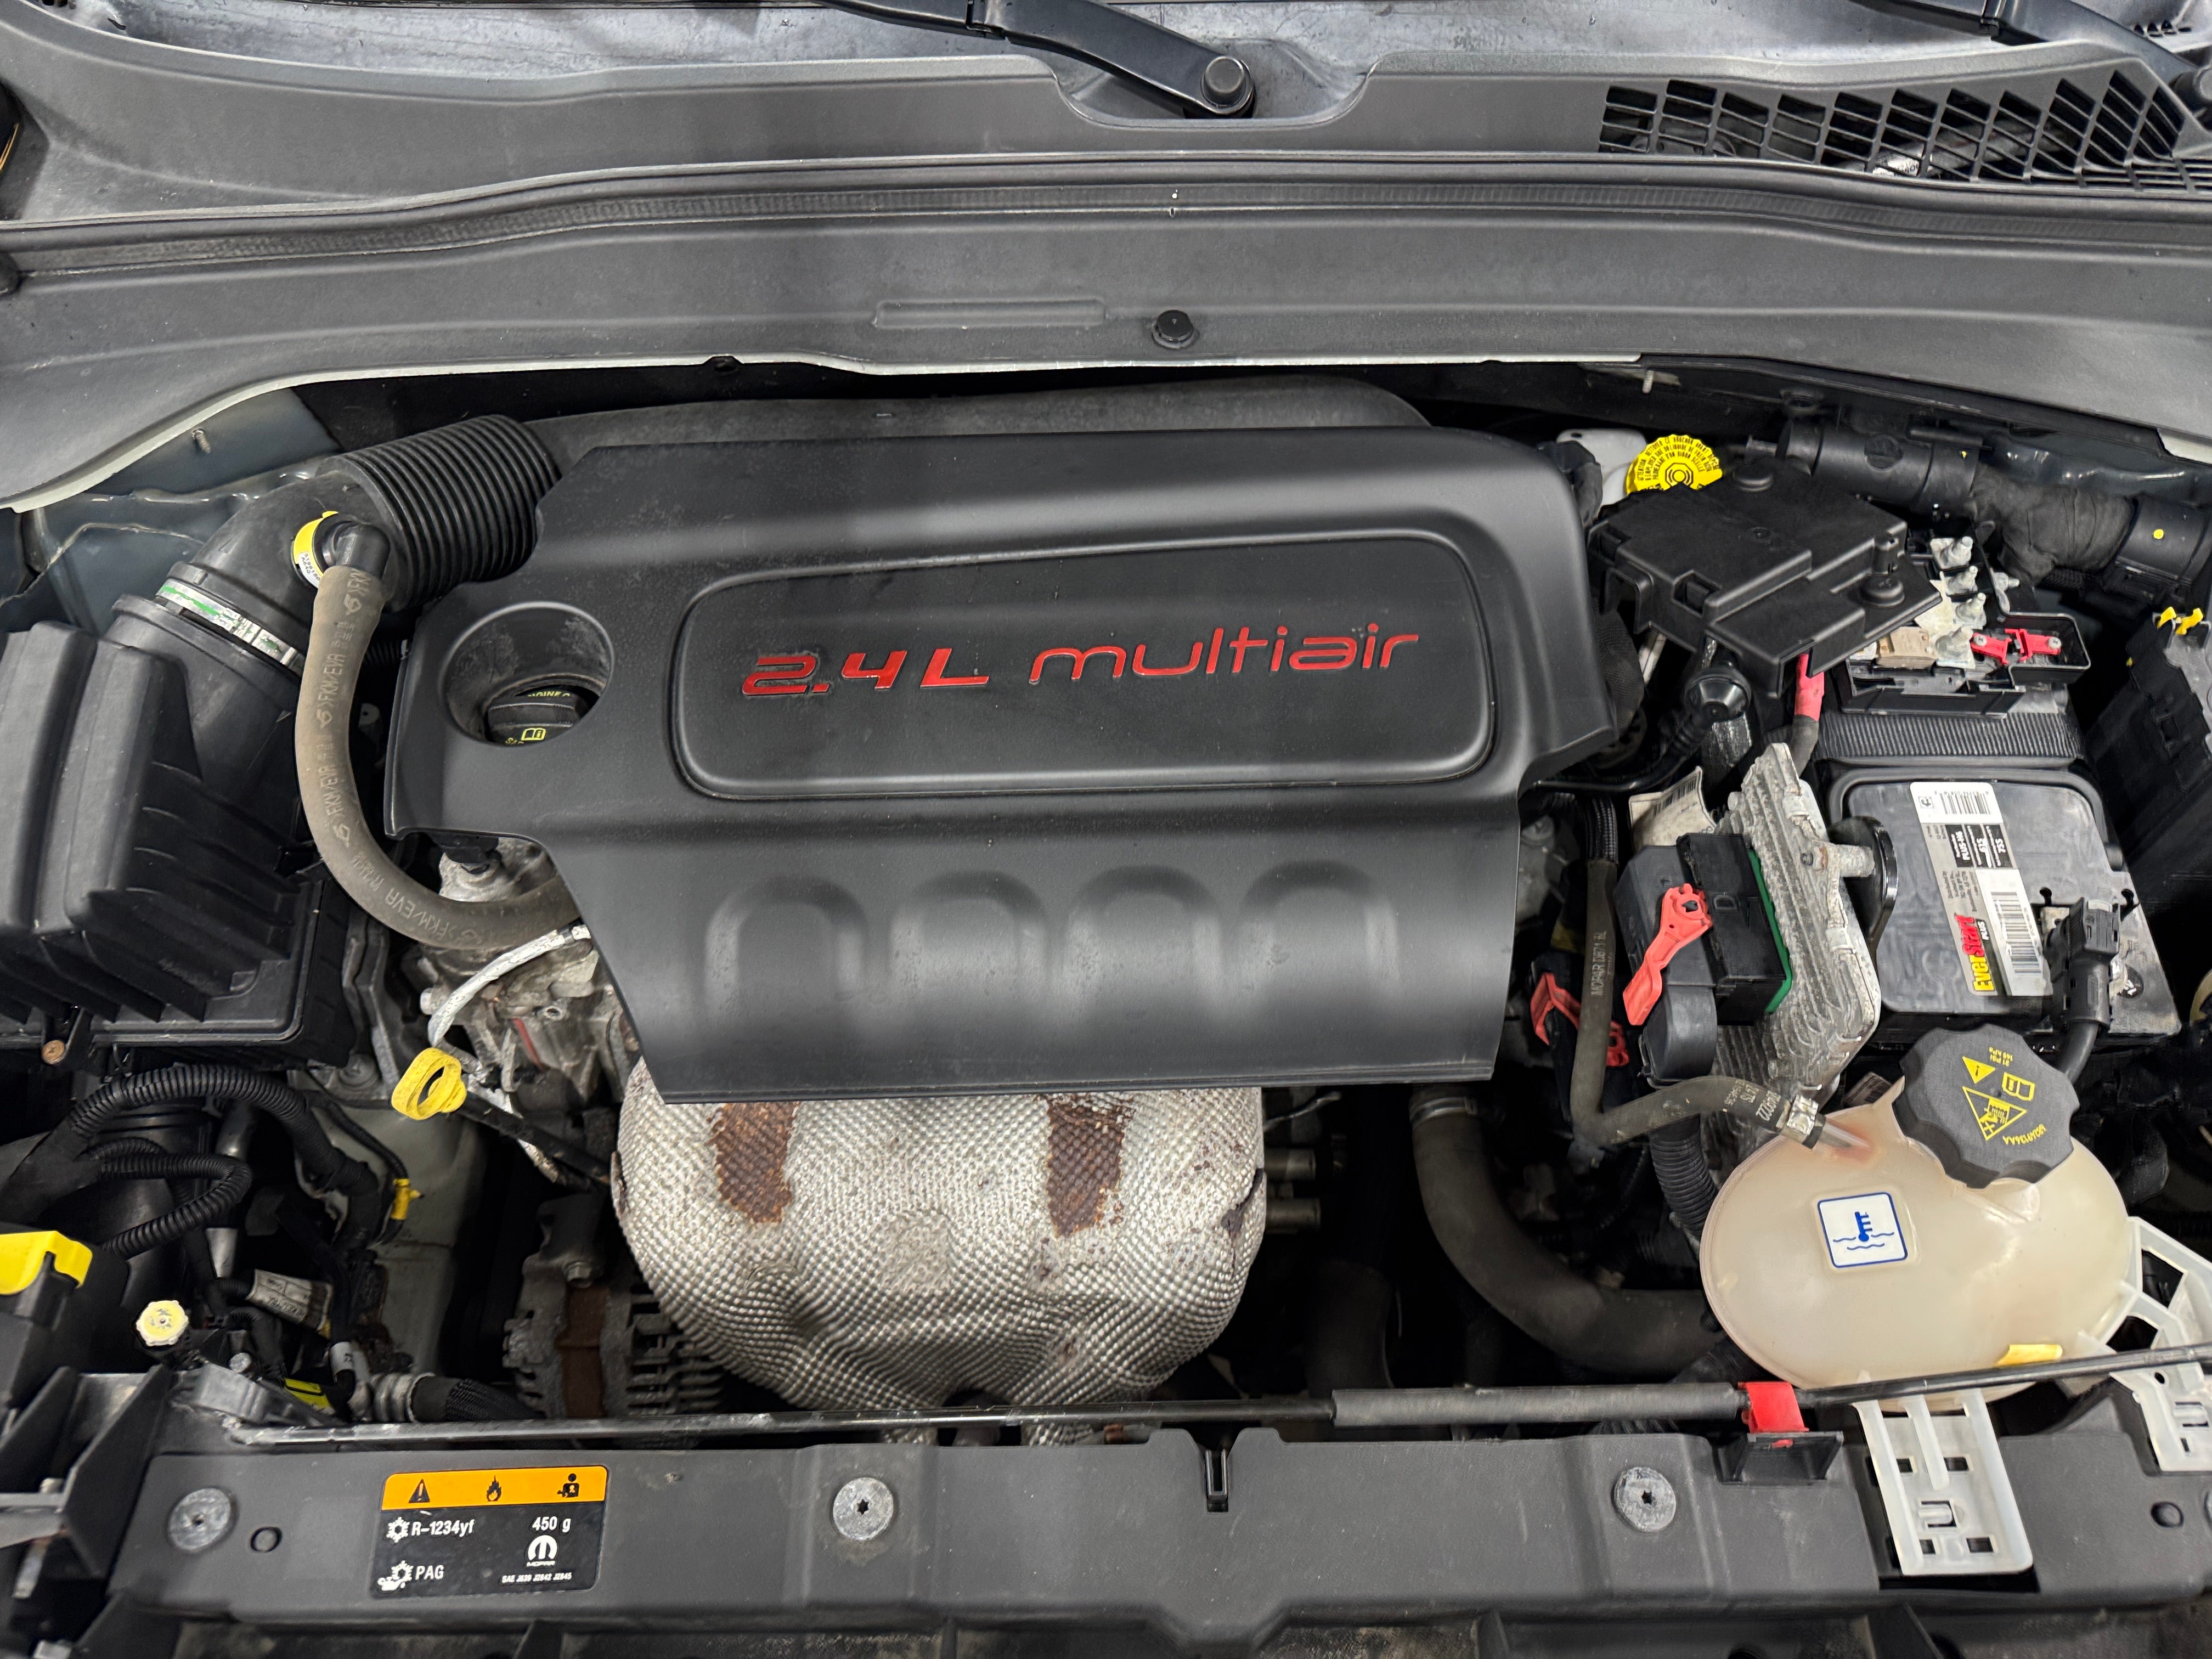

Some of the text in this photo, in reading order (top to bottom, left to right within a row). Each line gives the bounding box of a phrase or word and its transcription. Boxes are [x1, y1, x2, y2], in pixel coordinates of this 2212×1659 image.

[1029, 623, 1419, 684] multiair
[1977, 921, 1989, 941] PLUS
[1954, 913, 1994, 991] EverStart
[411, 1519, 475, 1538] R-1234yf
[532, 1516, 571, 1533] 450 g
[415, 1565, 444, 1580] PAG
